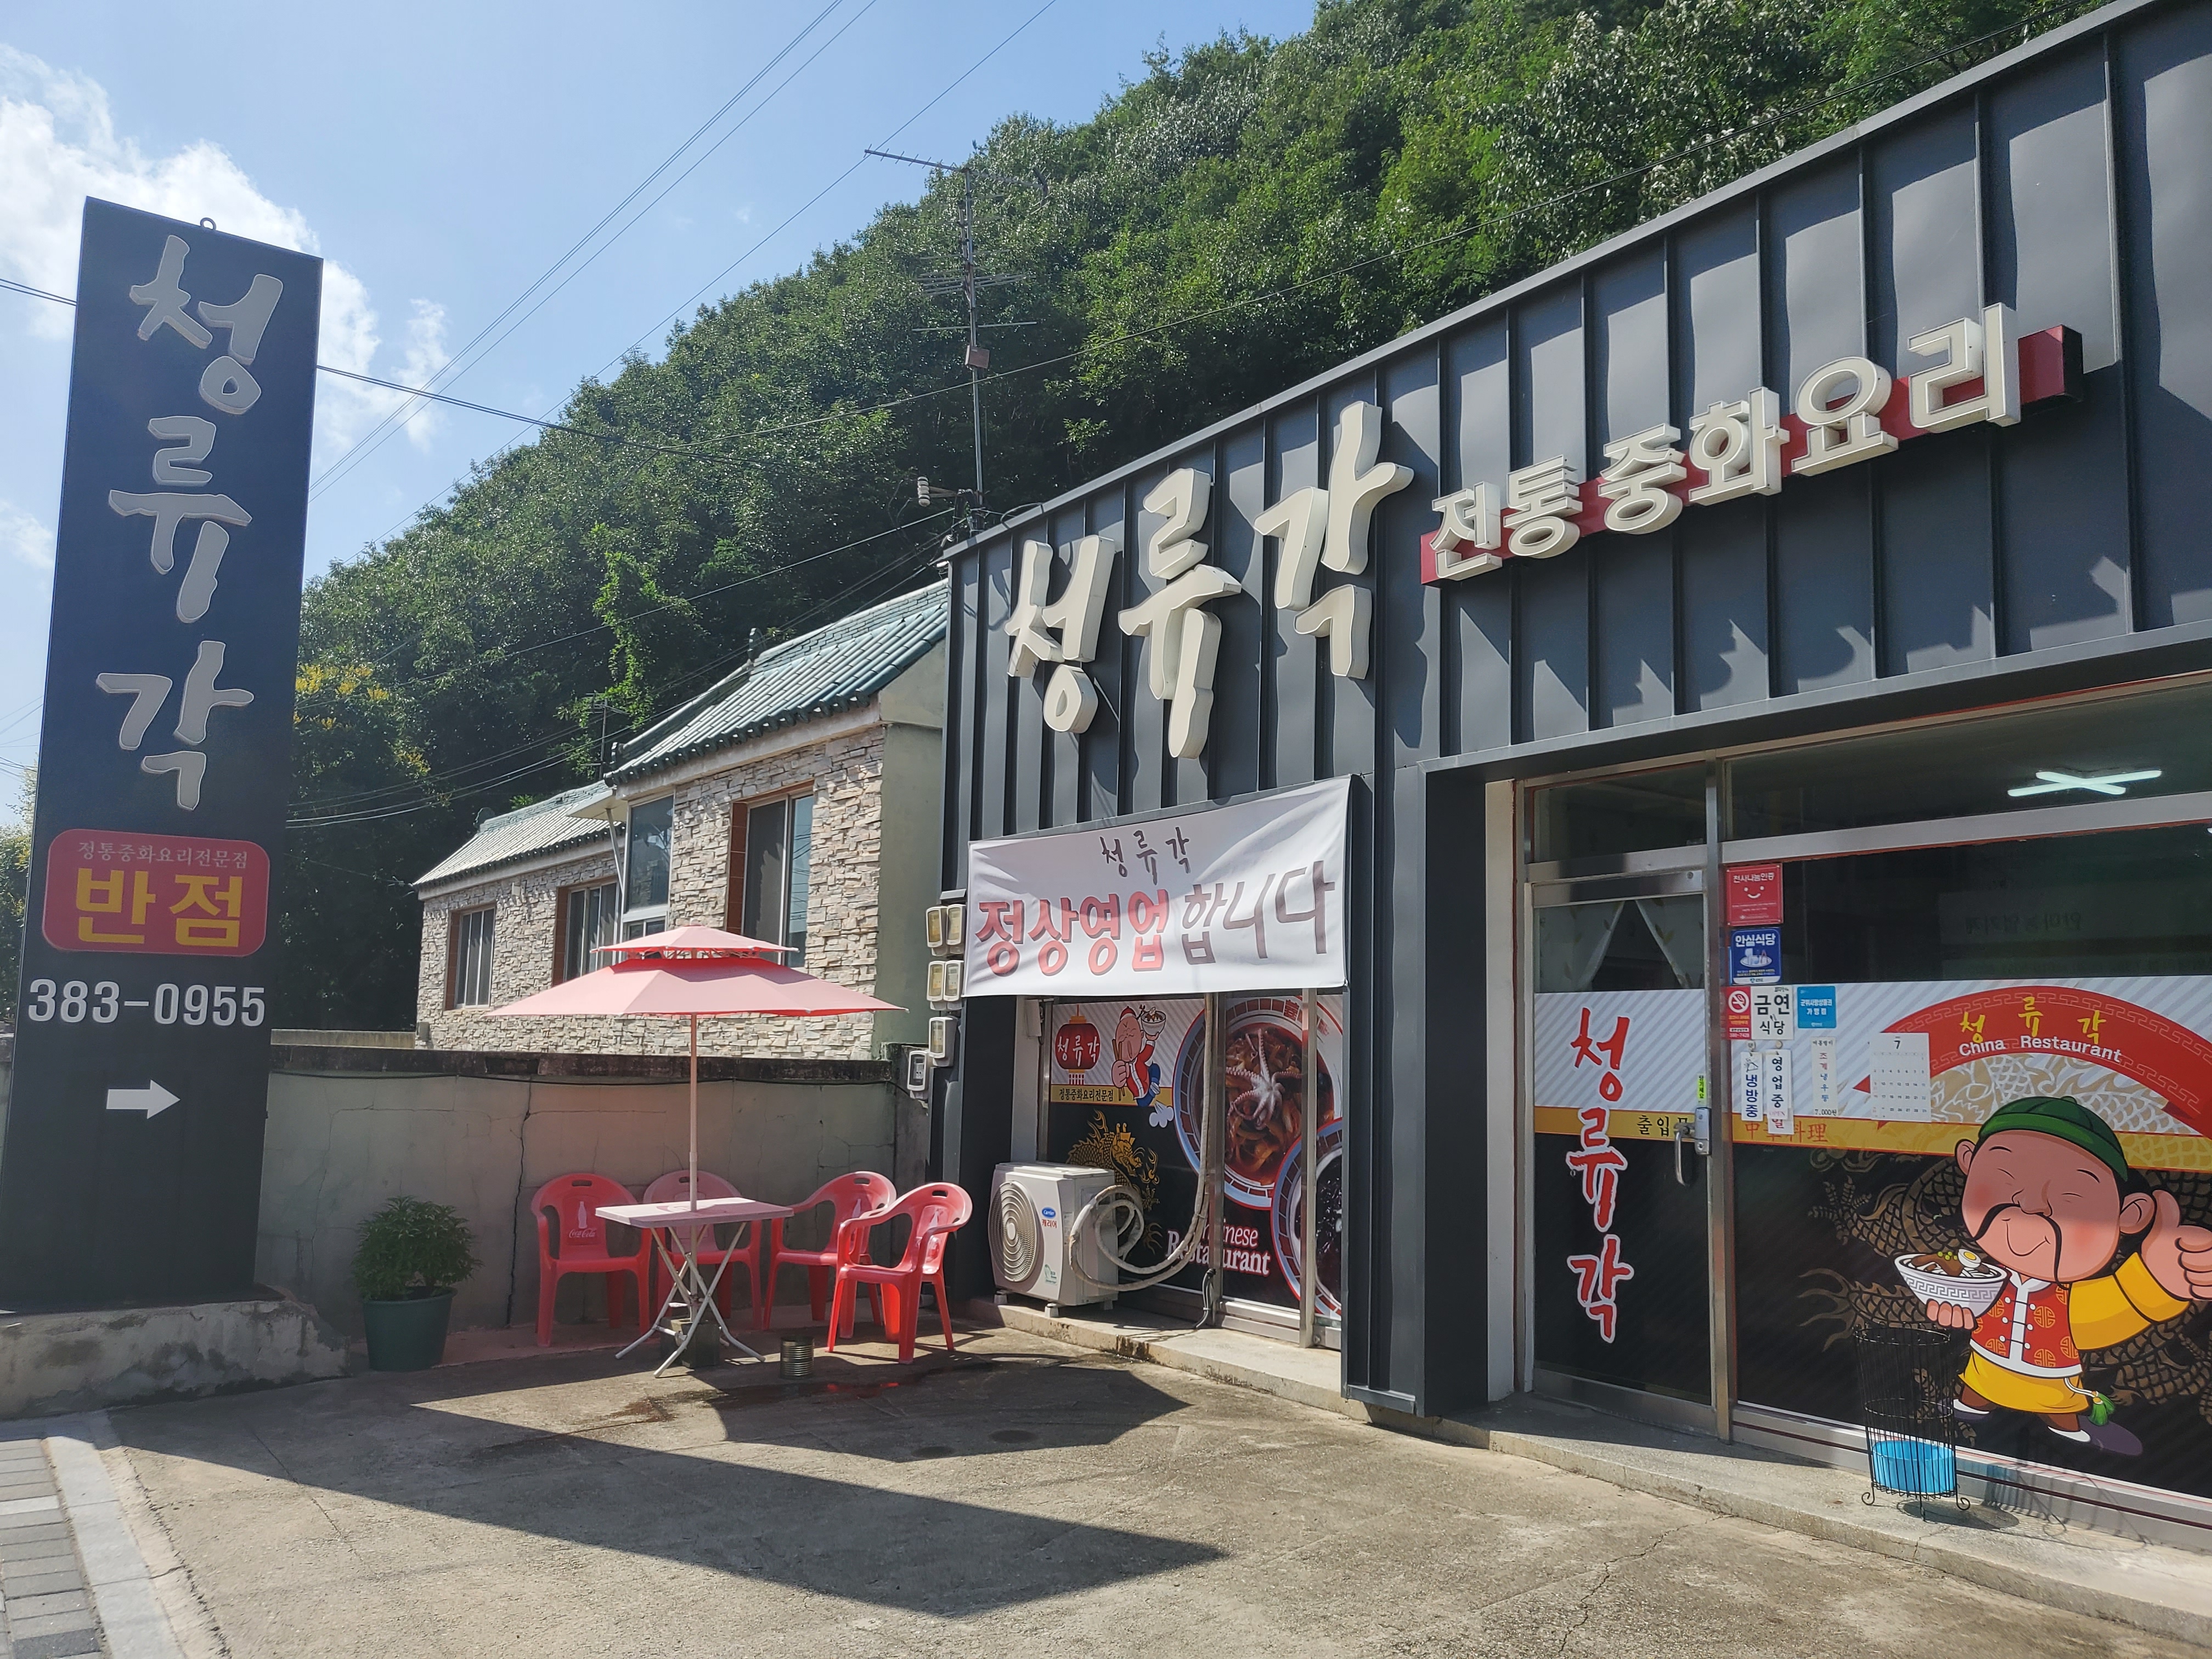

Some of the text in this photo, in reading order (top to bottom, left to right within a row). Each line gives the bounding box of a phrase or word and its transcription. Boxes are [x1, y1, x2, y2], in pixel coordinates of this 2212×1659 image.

[1431, 303, 2021, 580] 전통중화요리
[96, 235, 283, 810] 청류각
[1005, 401, 1414, 759] 청류각
[78, 841, 249, 869] 정통중화요리전문점
[1100, 827, 1189, 885] 청류각
[76, 867, 243, 948] 반점
[1735, 933, 1776, 947] 안심식당
[28, 979, 266, 1027] 383-0955
[1754, 994, 1790, 1015] 금연
[1960, 996, 2107, 1045] 청류각
[1759, 1020, 1785, 1035] 식당
[1893, 1040, 1900, 1049] 7
[1959, 1035, 2122, 1063] China Restaurant
[1058, 1035, 1099, 1067] 청류각
[1059, 1088, 1114, 1102] 정통중화요리전문점
[1746, 1074, 1758, 1118] 냉방중
[1771, 1057, 1784, 1108] 영업중
[1567, 1007, 1633, 1340] 청류각
[1042, 1219, 1057, 1228] 캐리어
